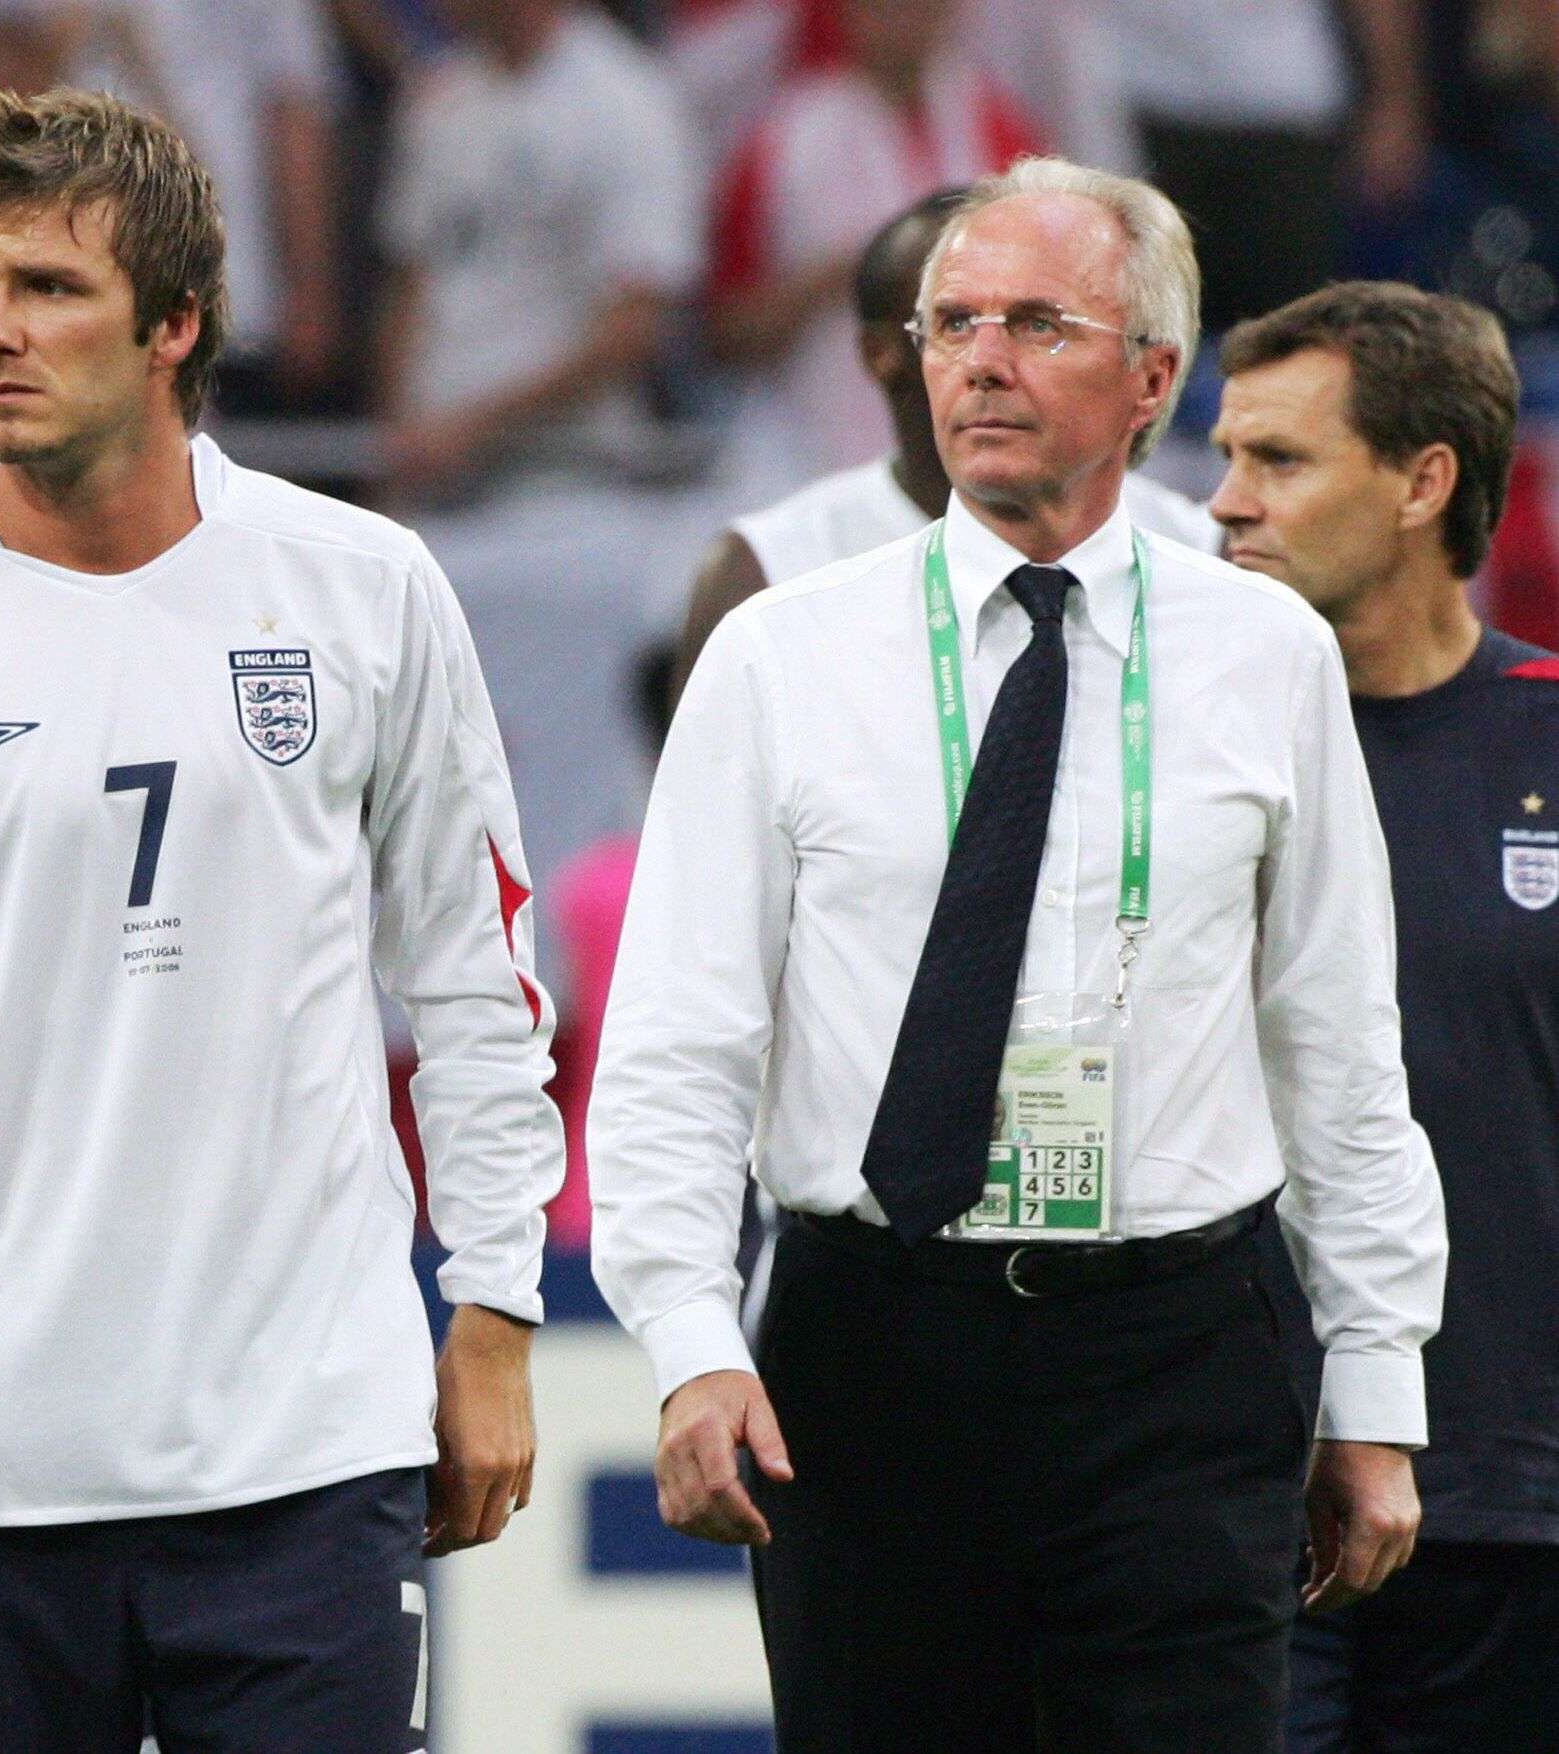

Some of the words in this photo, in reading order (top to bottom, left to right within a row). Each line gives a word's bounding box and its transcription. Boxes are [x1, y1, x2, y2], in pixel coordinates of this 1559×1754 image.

[235, 653, 306, 666] ENGLAND
[104, 761, 177, 907] 7
[123, 917, 182, 934] ENGLAND
[124, 944, 184, 962] PORTUGAL
[1027, 1152, 1037, 1168] 1
[1053, 1151, 1066, 1168] 2
[1079, 1152, 1092, 1169] 3
[1025, 1178, 1039, 1194] 4
[1052, 1178, 1065, 1195] 5
[1078, 1178, 1092, 1196] 6
[1025, 1203, 1039, 1220] 7
